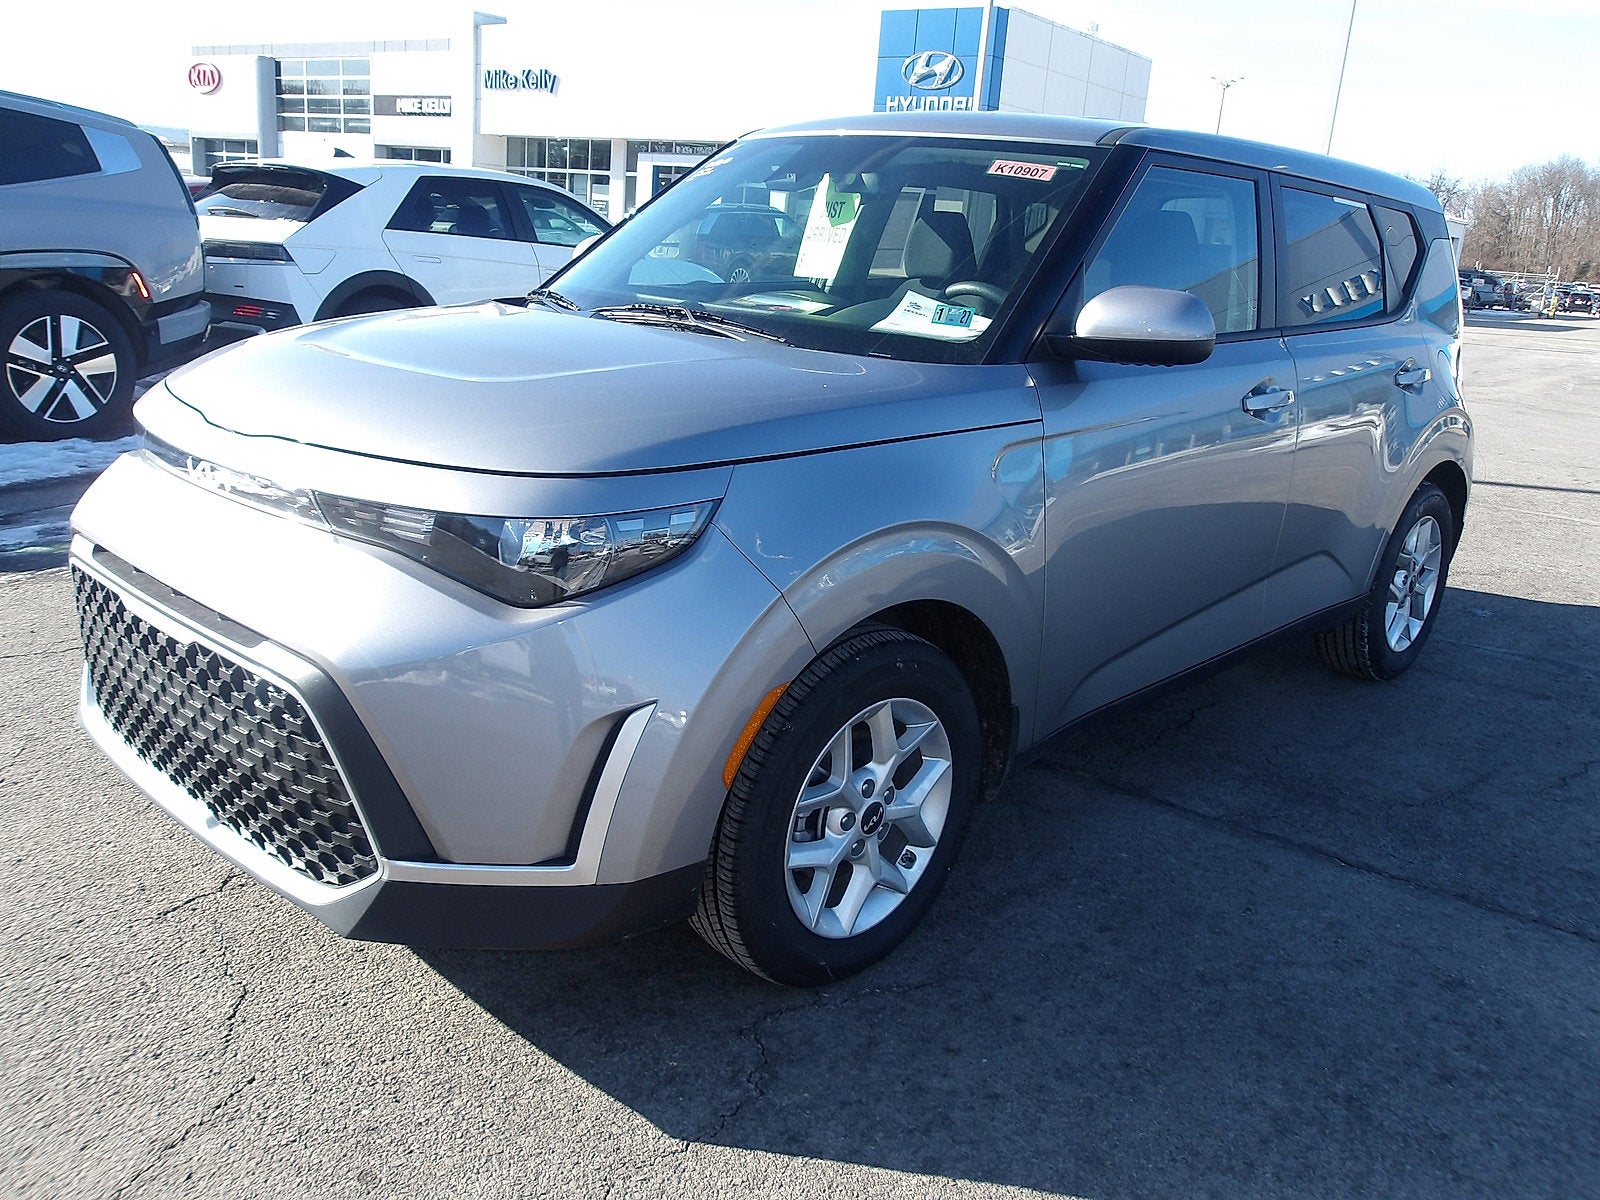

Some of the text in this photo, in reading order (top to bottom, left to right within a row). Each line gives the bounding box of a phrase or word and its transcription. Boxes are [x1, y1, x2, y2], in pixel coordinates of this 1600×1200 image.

[190, 67, 218, 88] KIA
[484, 69, 556, 94] Mike Kelly
[422, 97, 451, 115] KELLY
[886, 95, 973, 112] HYUNDAI
[994, 163, 1049, 179] K10907
[959, 309, 972, 325] 27
